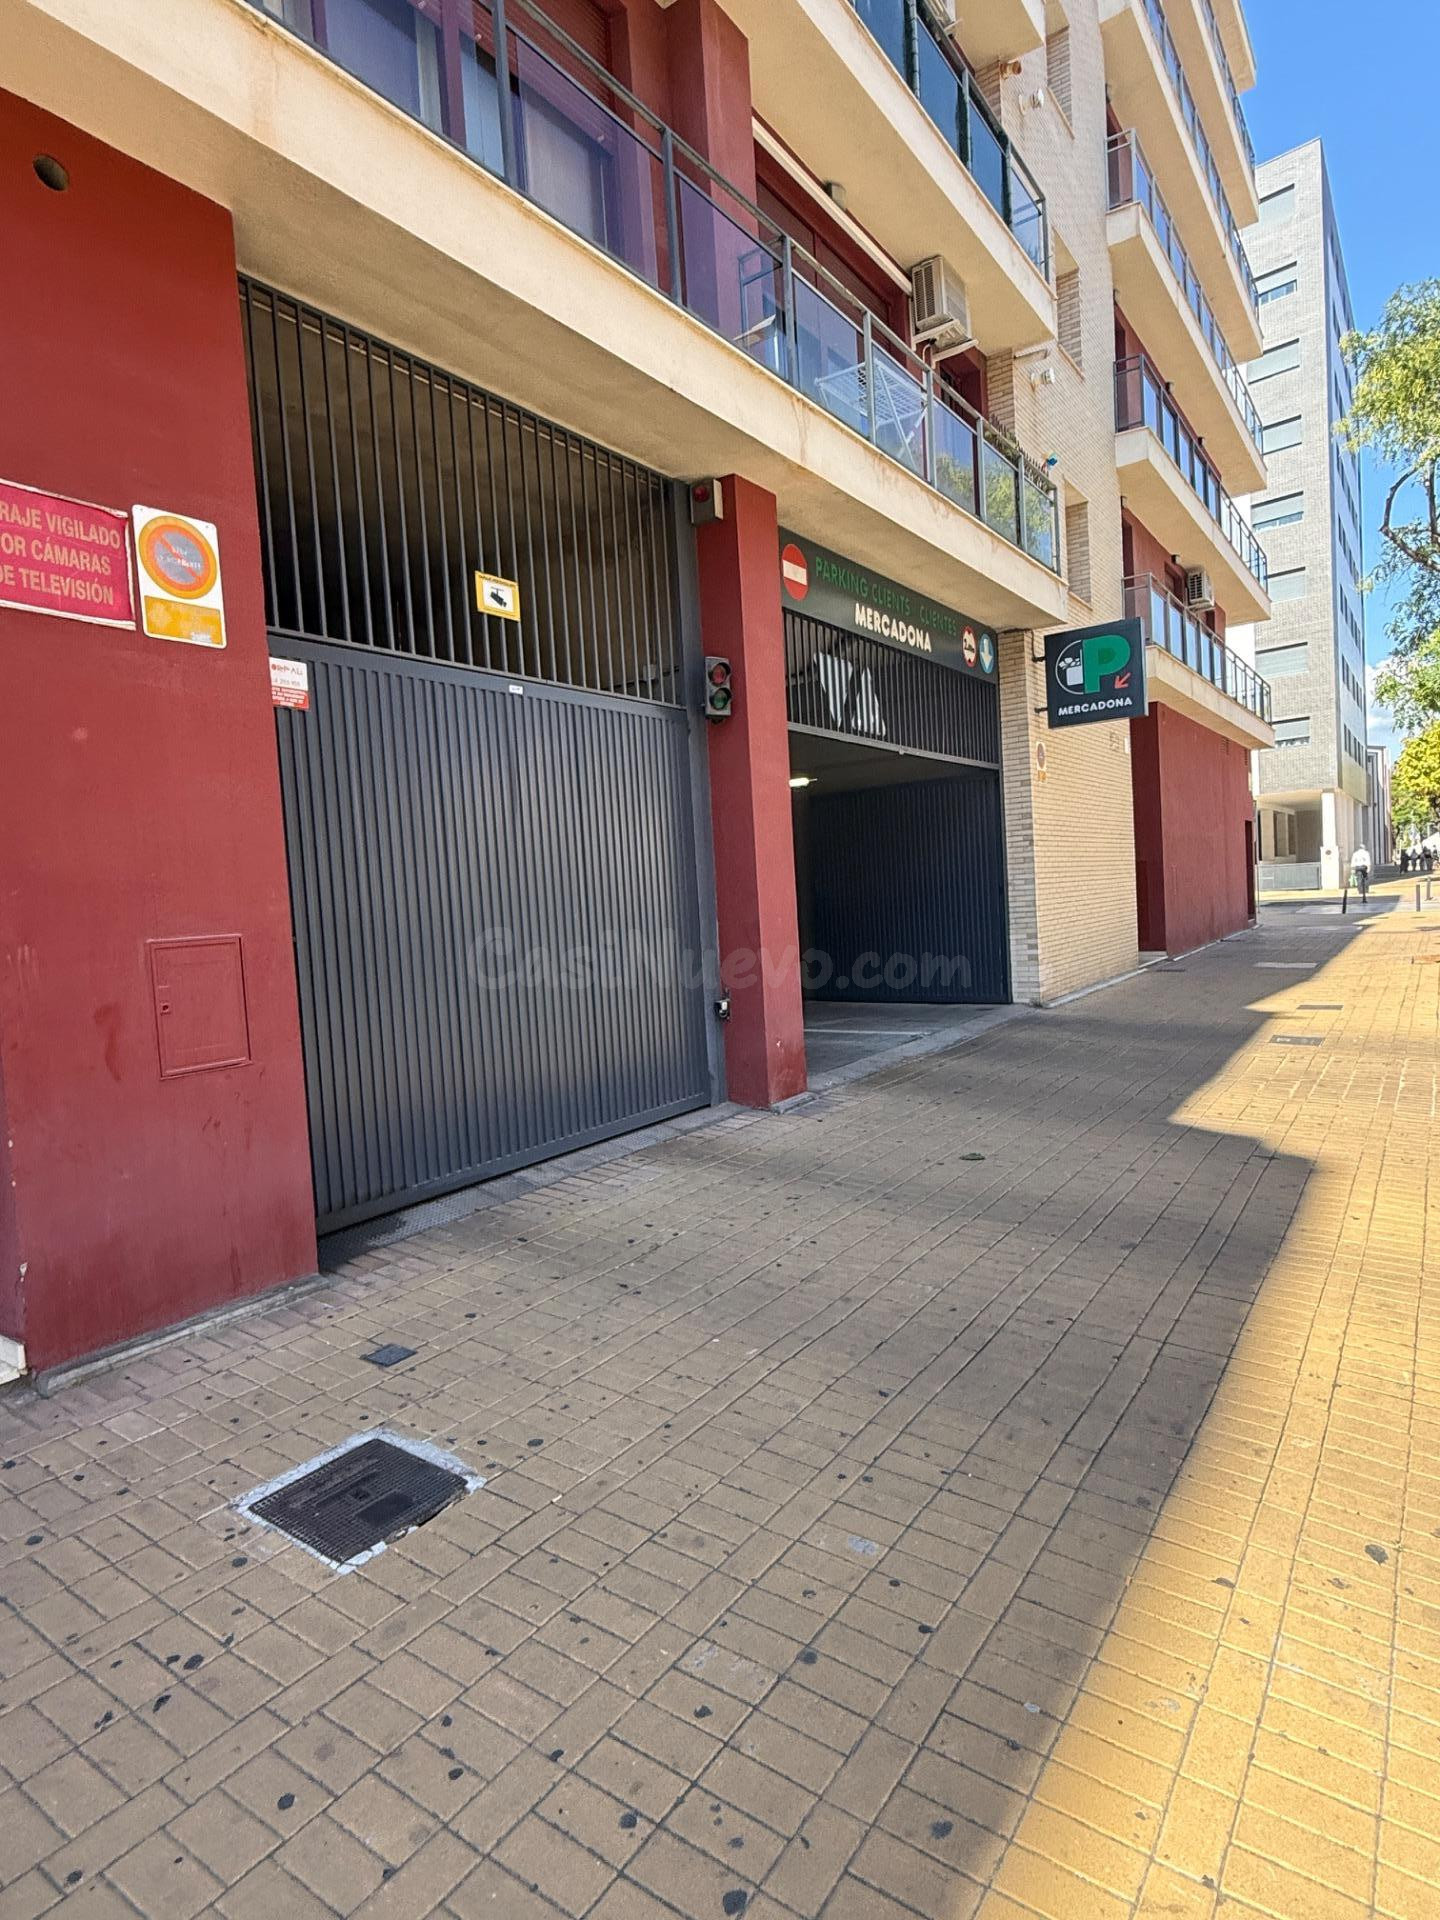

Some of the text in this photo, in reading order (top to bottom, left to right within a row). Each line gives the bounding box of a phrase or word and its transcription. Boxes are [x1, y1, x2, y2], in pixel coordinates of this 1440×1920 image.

[45, 511, 121, 549] VIGILADO
[1, 532, 112, 576] OR CÁMARAS
[18, 567, 114, 606] TELEVISIÓN
[815, 556, 957, 637] PARKING CLIENTS CLIENTES
[854, 602, 932, 653] MERCADONA
[1082, 634, 1131, 694] P
[1057, 697, 1133, 716] MERCADONA
